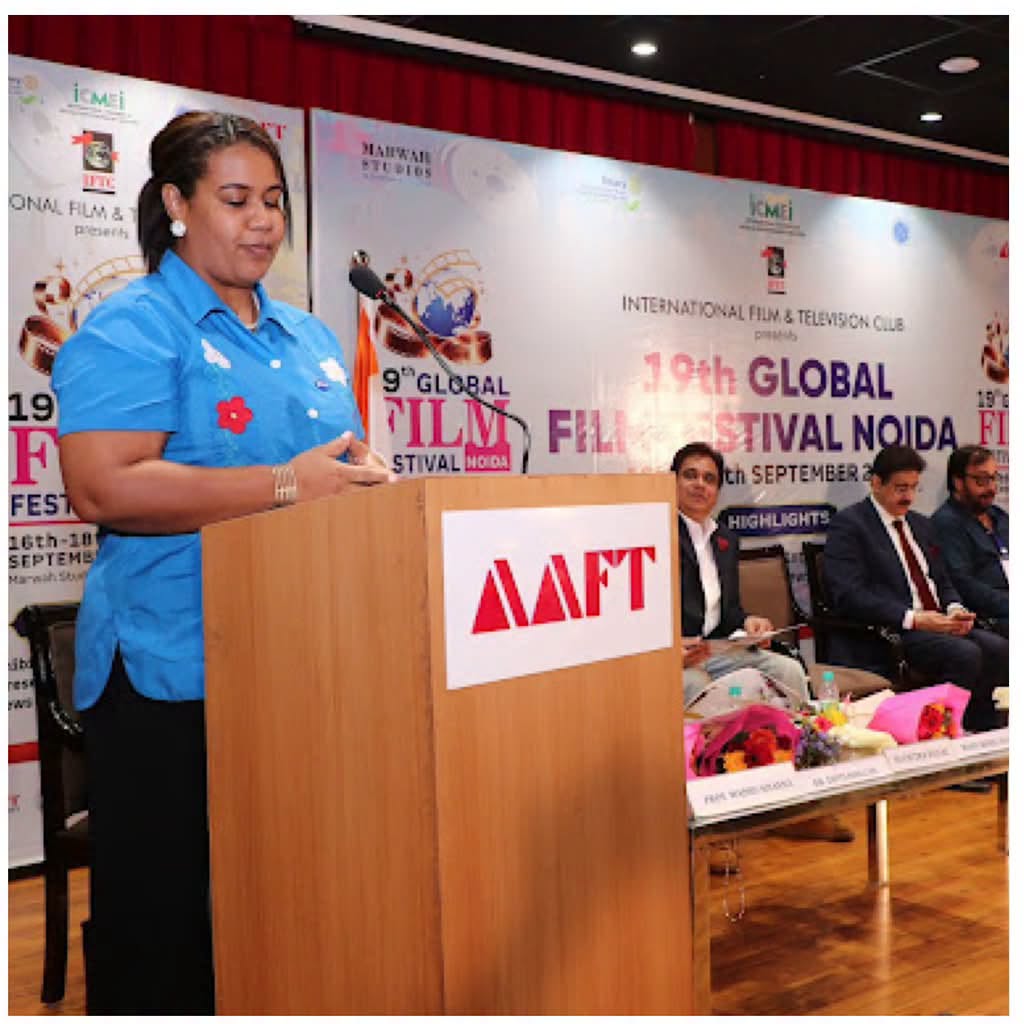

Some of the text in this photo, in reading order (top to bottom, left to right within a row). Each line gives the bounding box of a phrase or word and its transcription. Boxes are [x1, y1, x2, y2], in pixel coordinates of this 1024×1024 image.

[361, 160, 432, 178] STUDIOS
[68, 201, 106, 219] FILM
[112, 207, 125, 222] &
[622, 295, 905, 332] INTERNATIONAL FILM & TELEVISION CLUB
[417, 373, 511, 396] GLOBAL
[643, 351, 894, 400] 19th GLOBAL
[851, 413, 959, 451] NOIDA
[466, 455, 508, 470] NOIDA
[752, 464, 859, 485] SEPTEMBER
[728, 510, 830, 530] HIGHLIGHTS
[471, 546, 657, 634] AAFT
